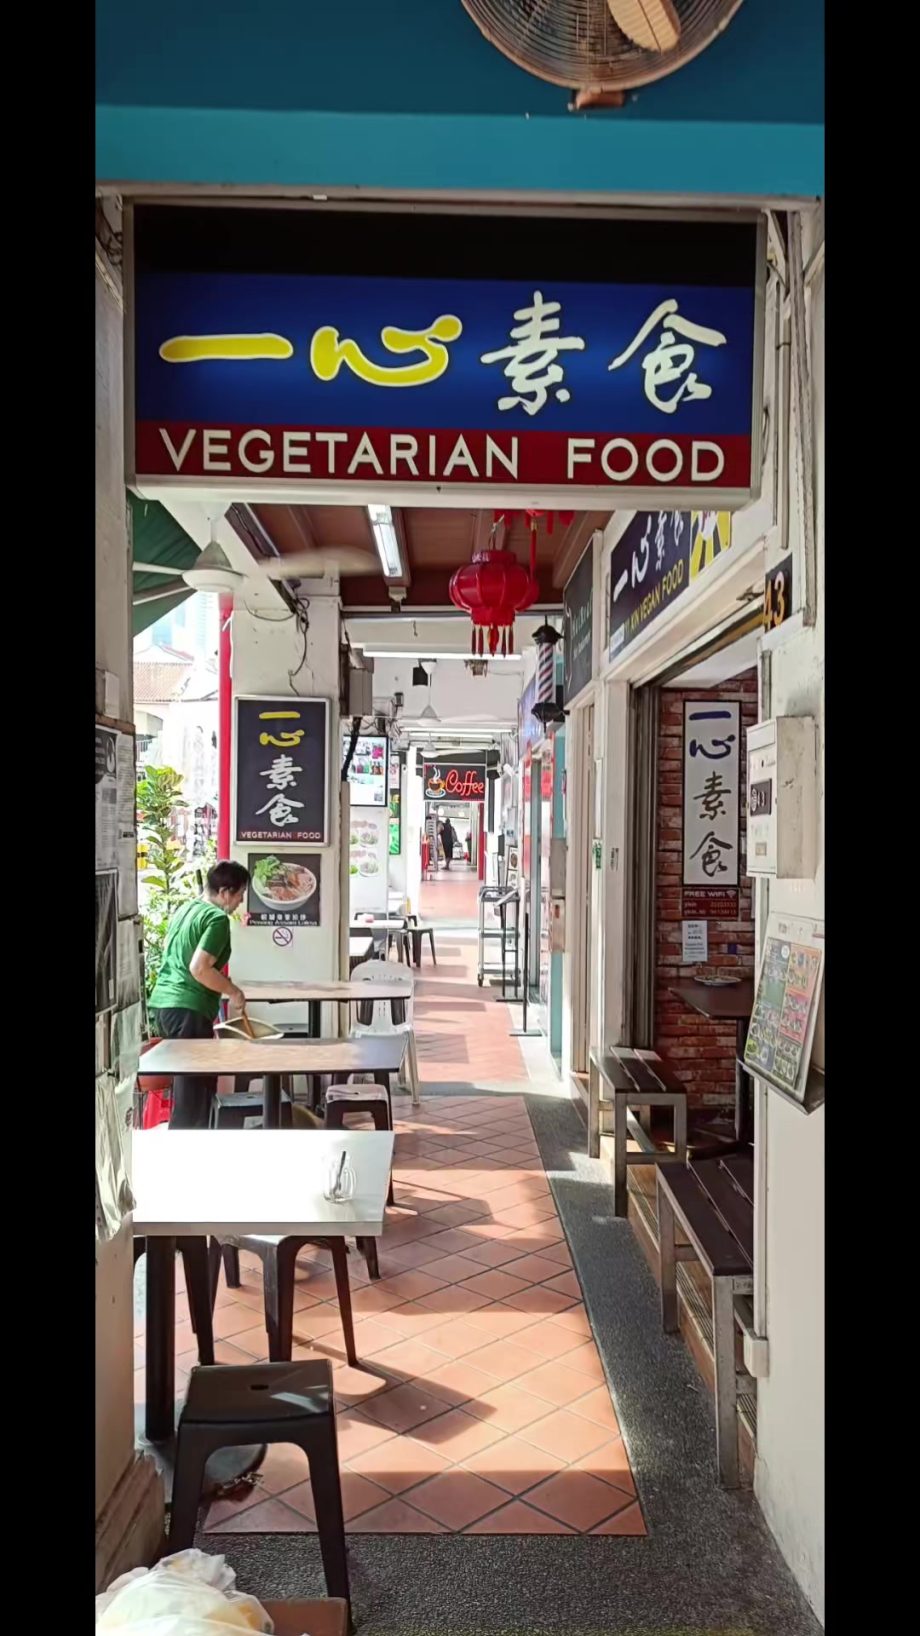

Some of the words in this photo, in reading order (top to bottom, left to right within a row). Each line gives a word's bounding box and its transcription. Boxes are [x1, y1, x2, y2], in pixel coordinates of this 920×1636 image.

[158, 290, 727, 415] 一心素食
[158, 427, 520, 480] VEGETARIAN
[566, 437, 726, 483] FOOD
[640, 582, 661, 620] VEGAN
[661, 559, 684, 598] FOOD
[763, 571, 785, 628] 43
[255, 711, 305, 827] 一心素食
[445, 769, 485, 796] Coffee
[688, 710, 736, 878] 一心素食
[241, 831, 292, 839] VEGETARIAN
